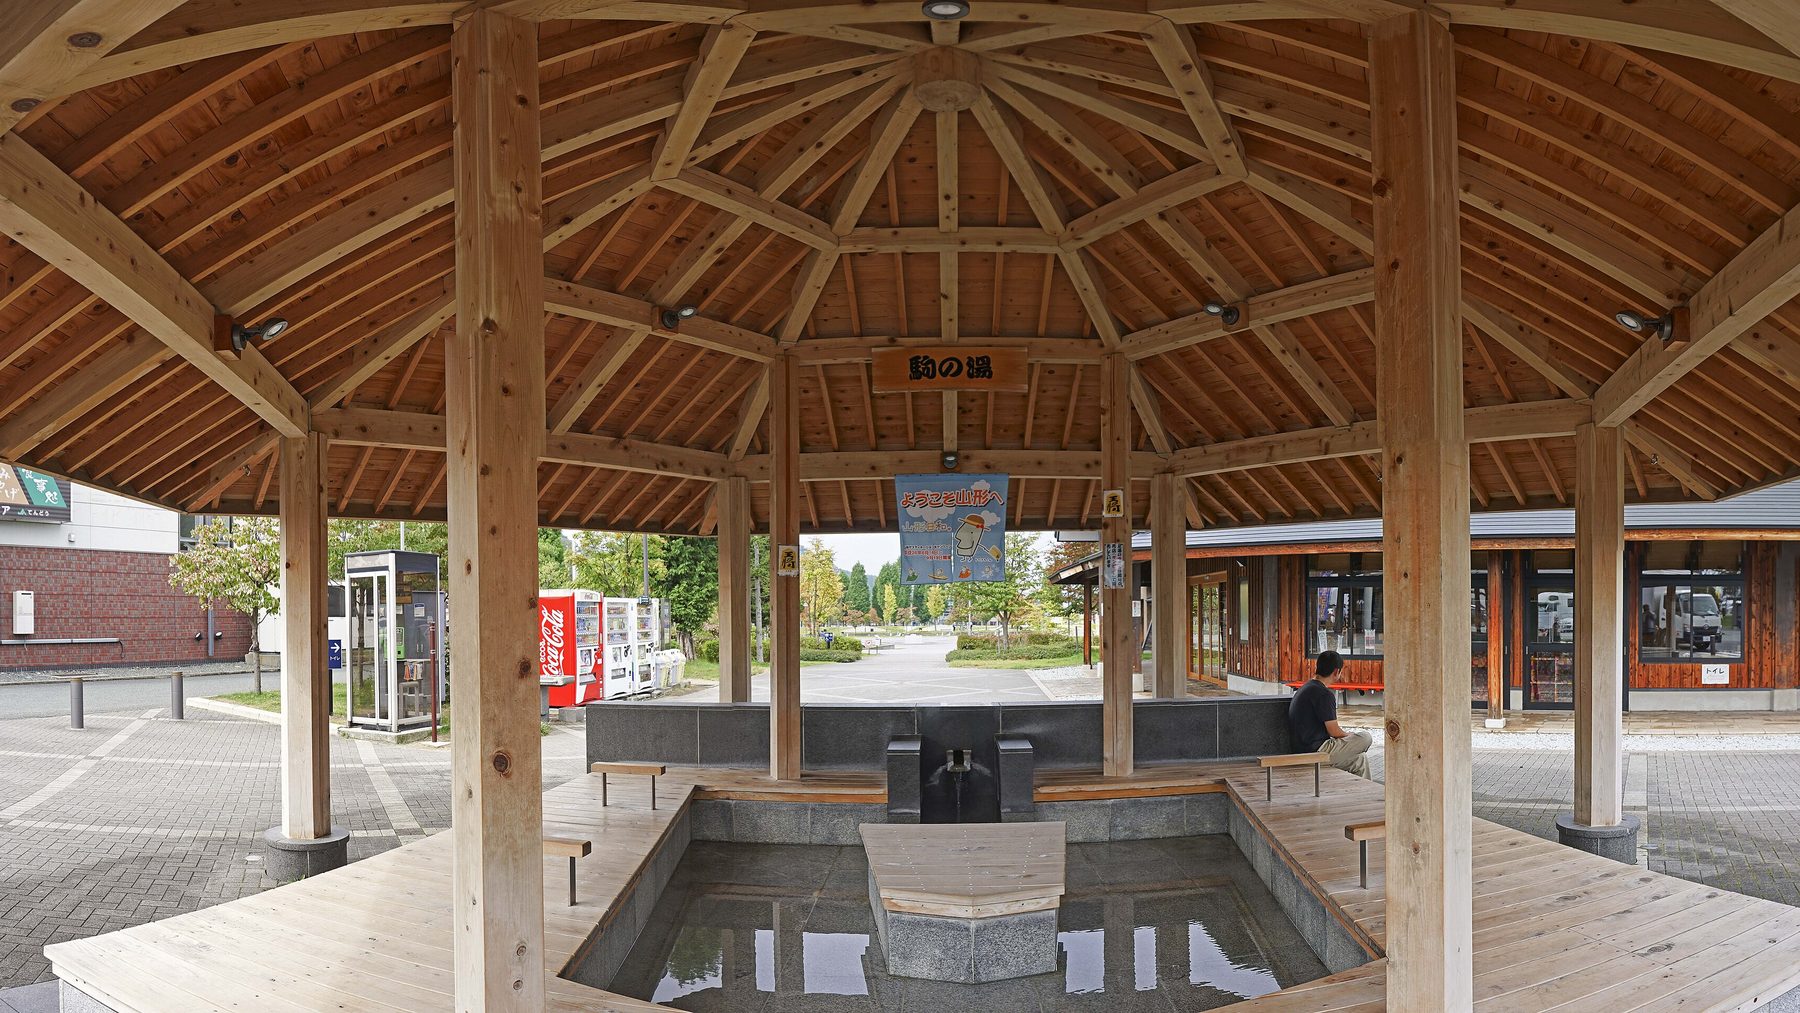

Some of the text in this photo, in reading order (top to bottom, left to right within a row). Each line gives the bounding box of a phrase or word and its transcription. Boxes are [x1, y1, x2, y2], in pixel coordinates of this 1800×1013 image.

[909, 355, 993, 381] 駒の湯
[901, 488, 1005, 508] ようこそ山形へ
